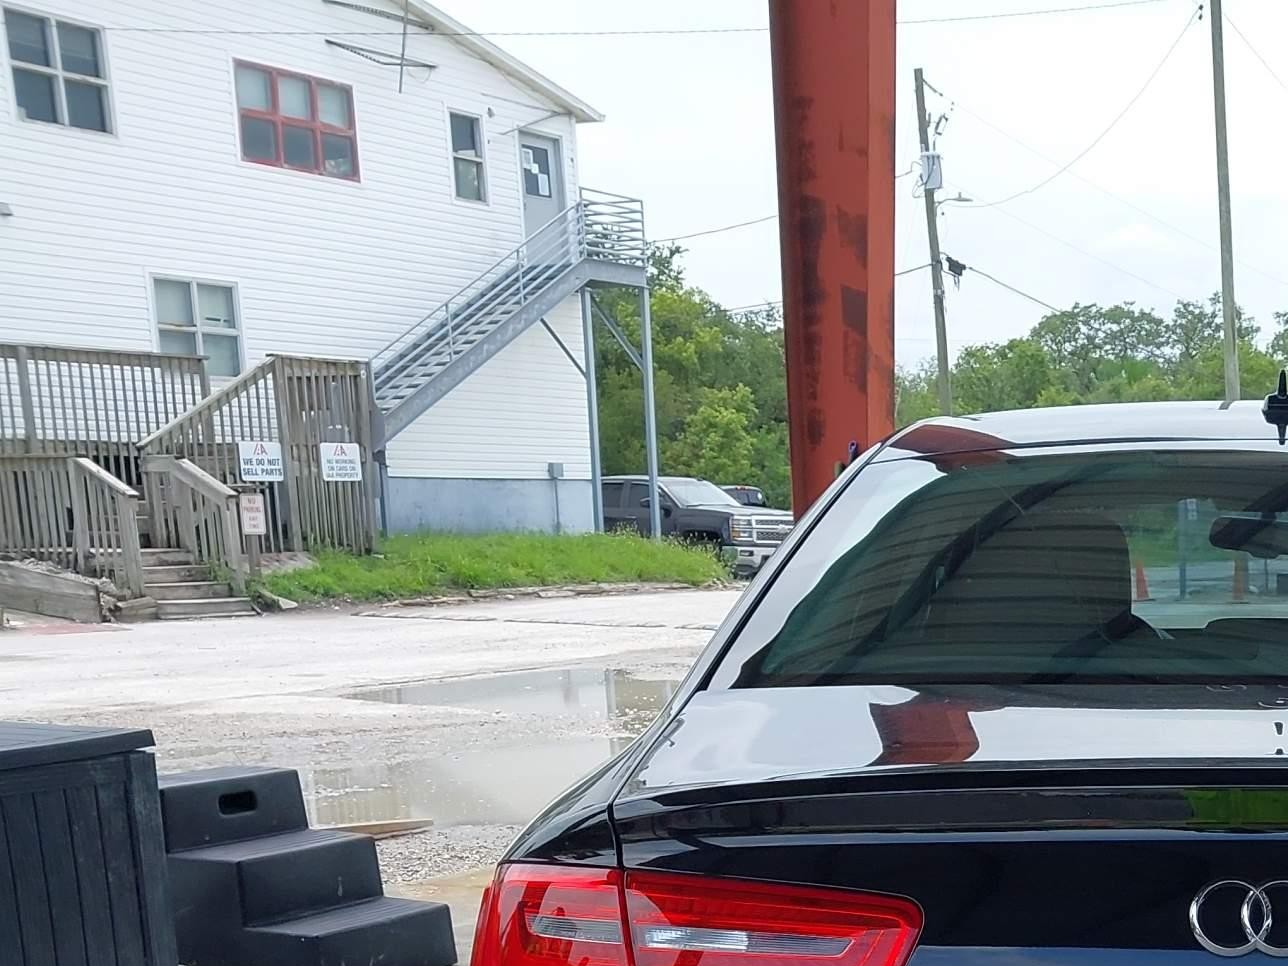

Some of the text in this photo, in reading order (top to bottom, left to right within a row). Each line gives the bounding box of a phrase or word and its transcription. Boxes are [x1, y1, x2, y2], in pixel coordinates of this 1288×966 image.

[243, 458, 280, 466] WE DO NOT
[243, 467, 282, 476] SELL PARTS
